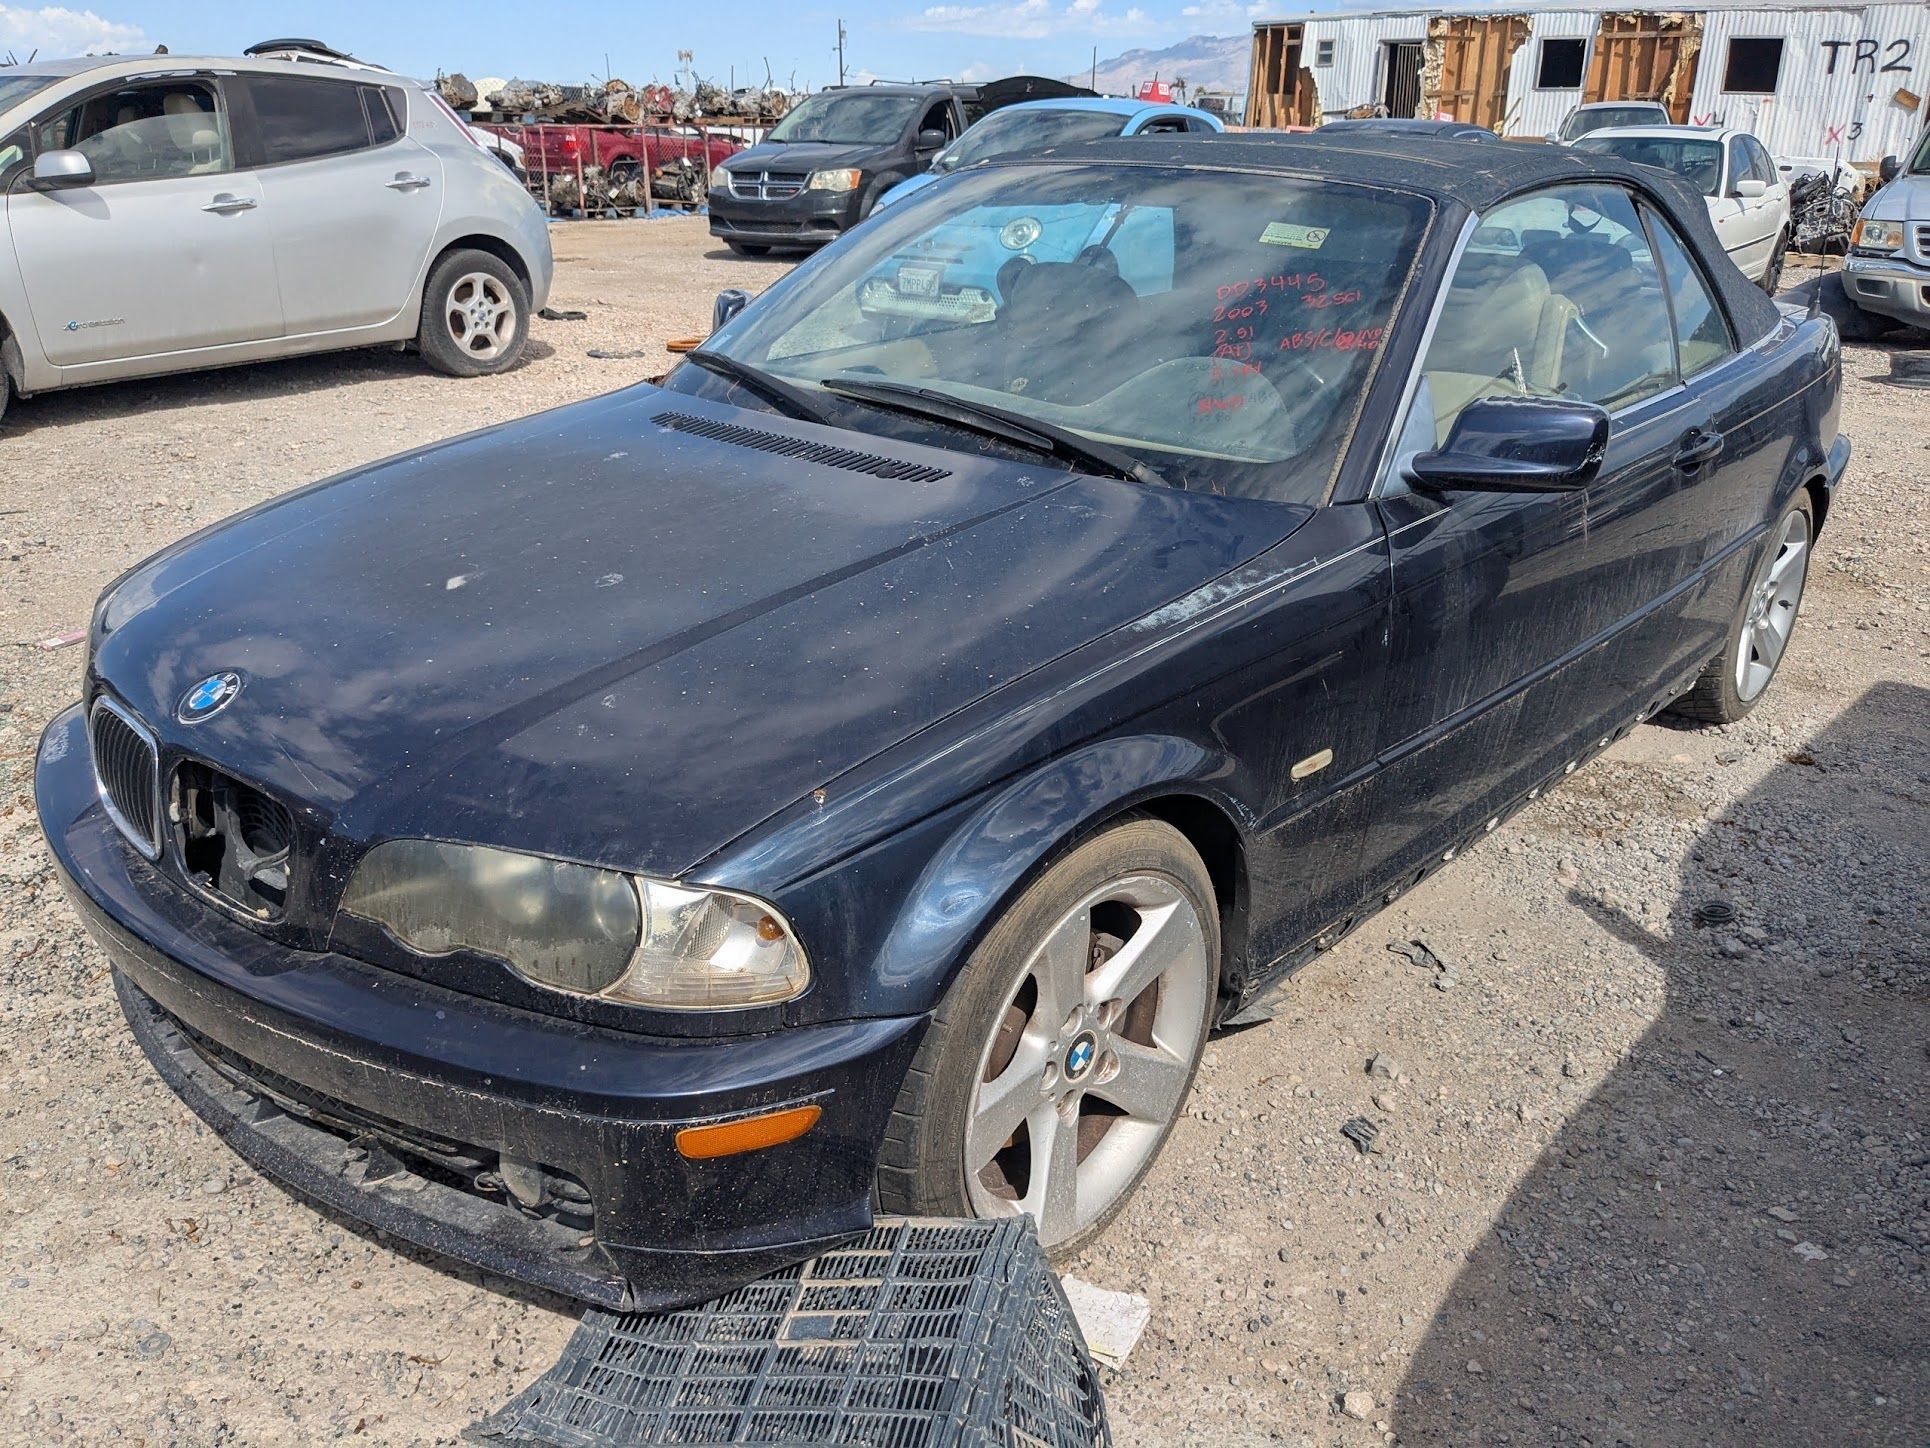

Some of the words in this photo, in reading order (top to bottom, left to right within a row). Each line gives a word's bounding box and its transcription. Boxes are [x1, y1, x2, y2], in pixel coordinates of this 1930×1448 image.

[1821, 39, 1912, 75] TR2
[1847, 121, 1863, 140] 3
[1213, 300, 1268, 322] 2003
